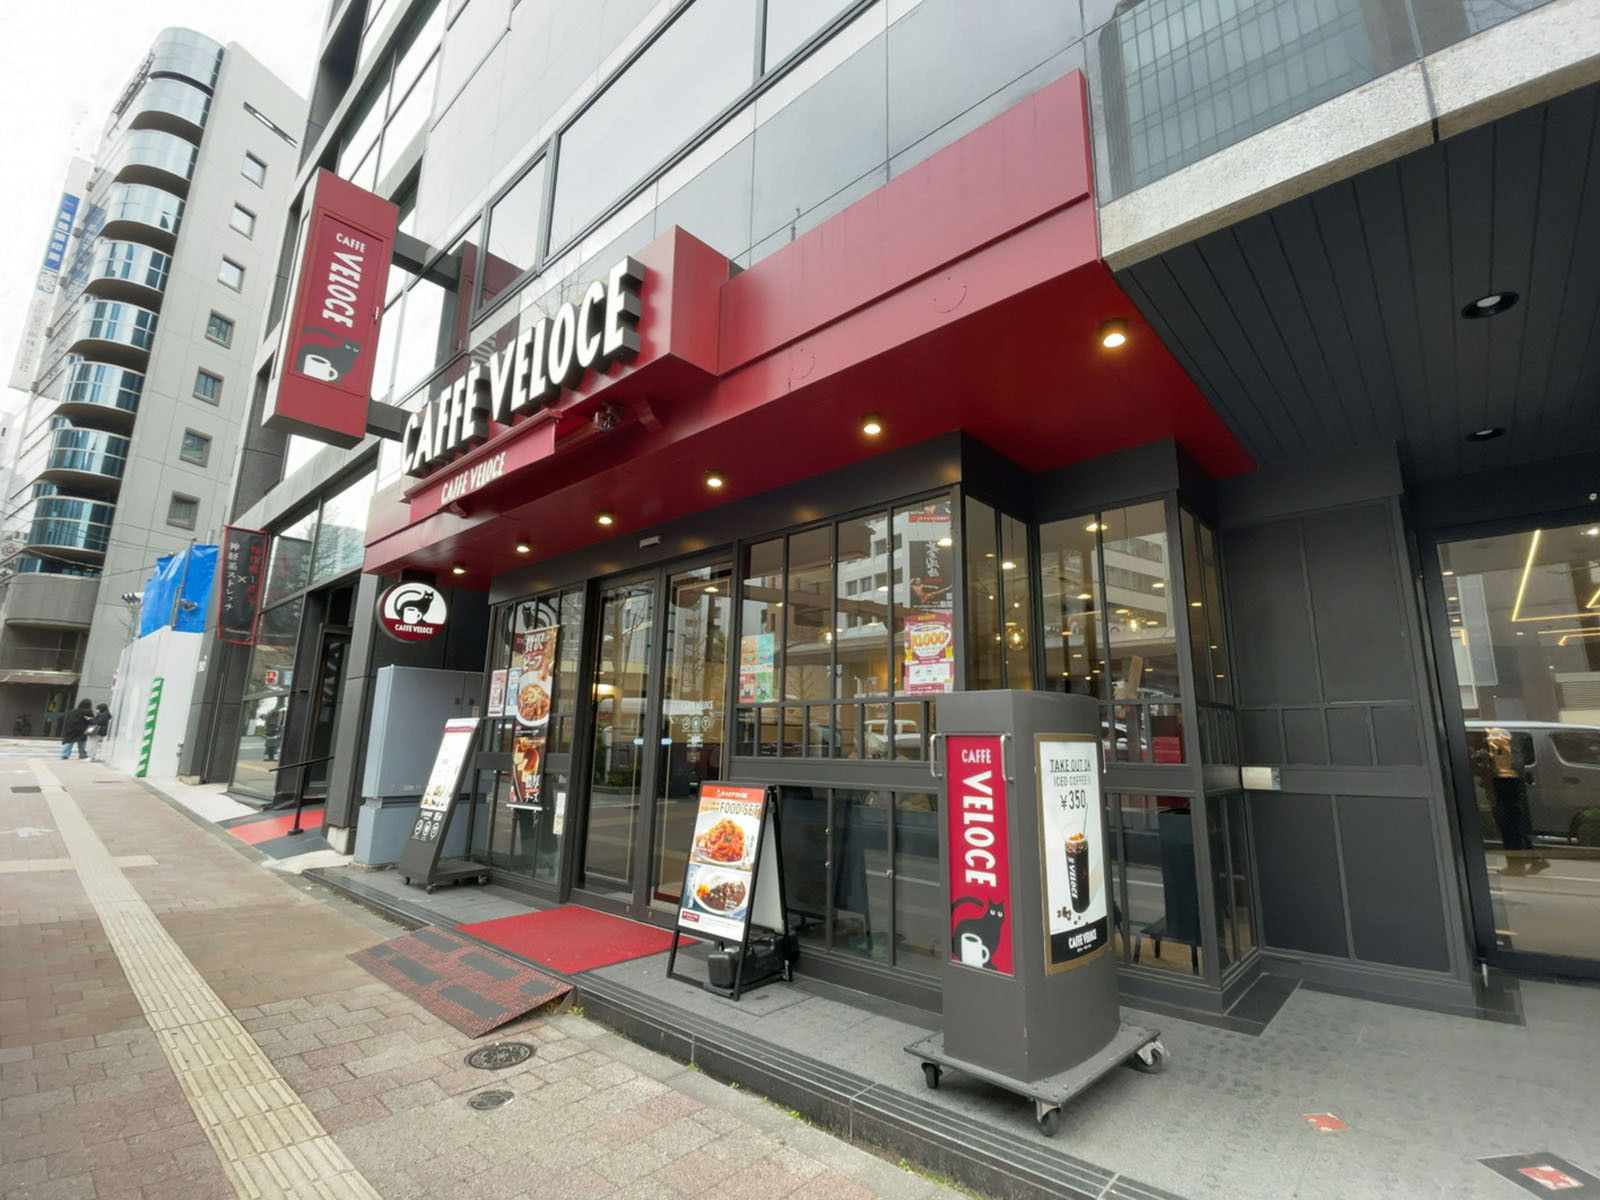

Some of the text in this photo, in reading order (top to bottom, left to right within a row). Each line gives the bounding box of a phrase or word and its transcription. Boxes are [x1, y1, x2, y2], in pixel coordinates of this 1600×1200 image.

[322, 251, 364, 328] VELOCE
[489, 256, 630, 422] VELOCE
[470, 451, 506, 490] VELOCE
[413, 626, 433, 635] VELOCE
[1049, 759, 1069, 772] TAKE
[720, 801, 741, 815] FOOD
[1060, 789, 1086, 810] ¥350
[962, 770, 997, 887] VELOCE
[1069, 865, 1078, 899] VELOCE
